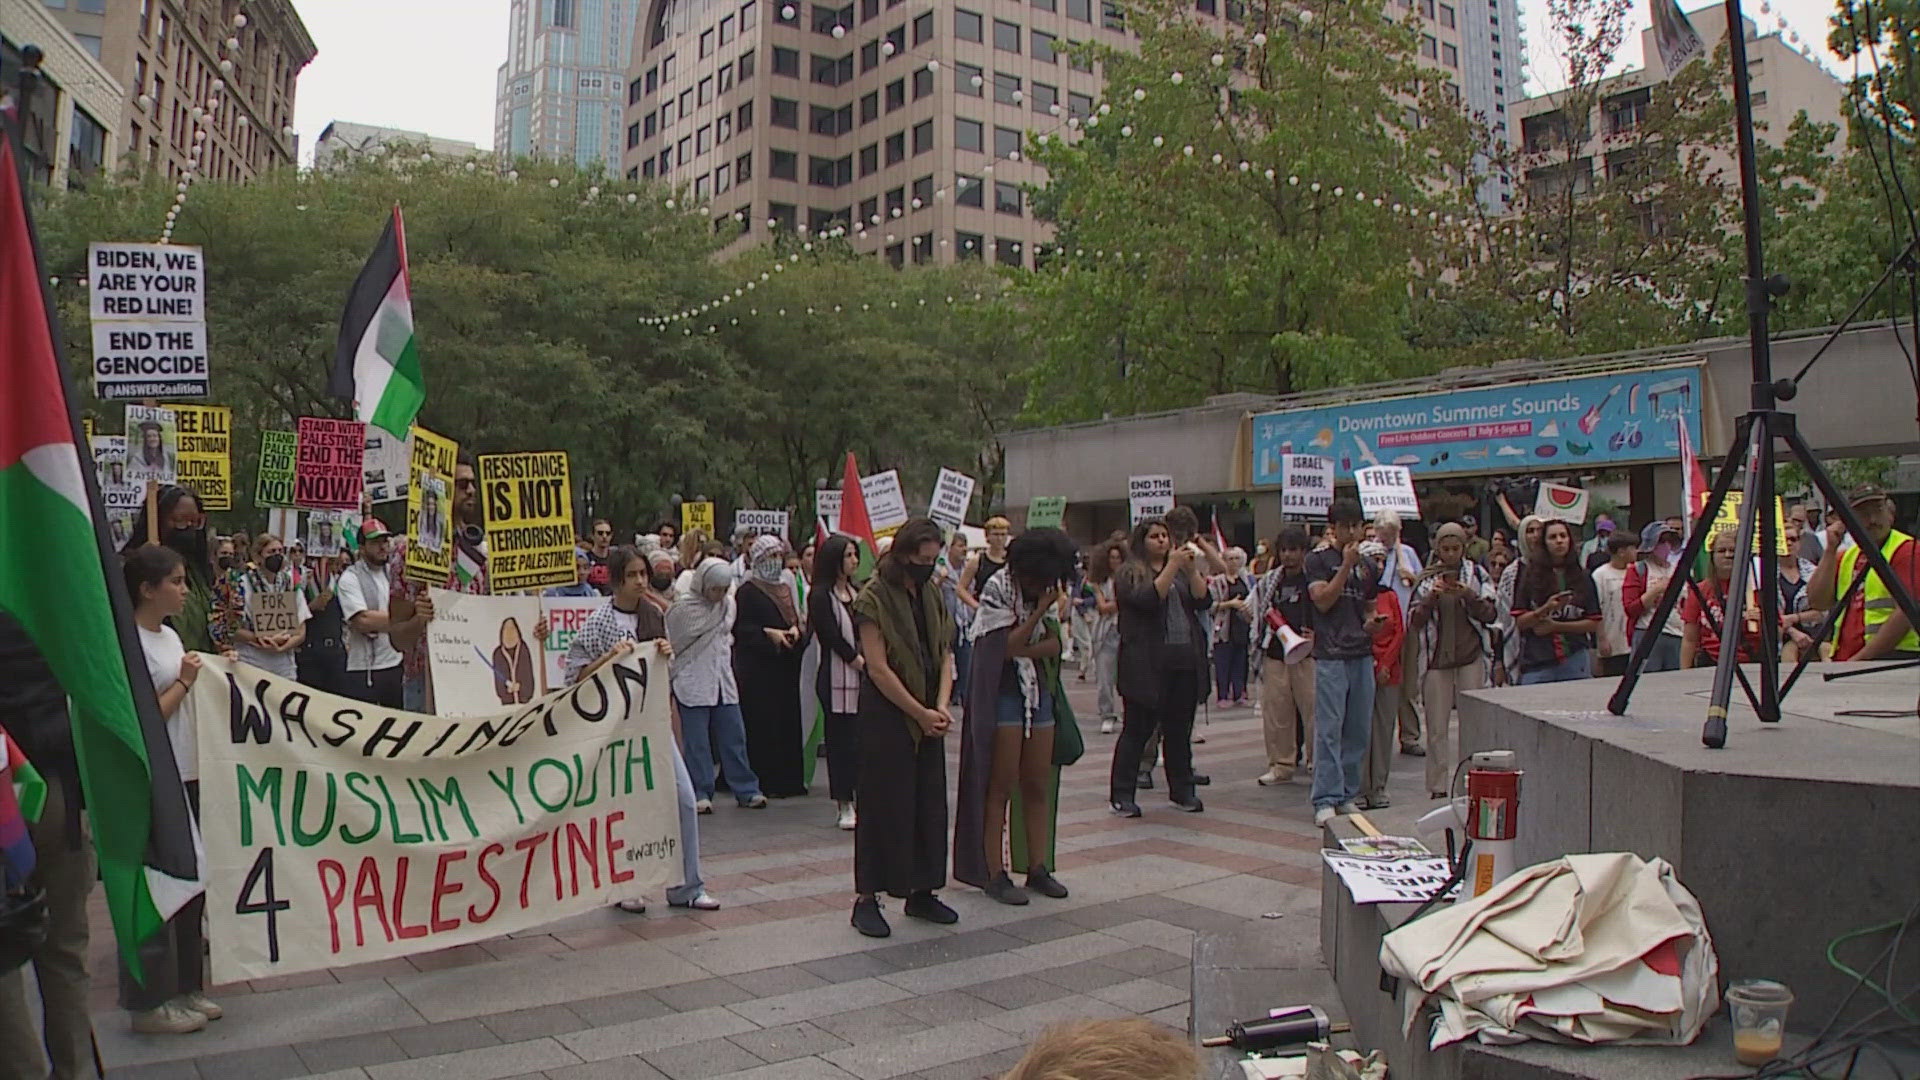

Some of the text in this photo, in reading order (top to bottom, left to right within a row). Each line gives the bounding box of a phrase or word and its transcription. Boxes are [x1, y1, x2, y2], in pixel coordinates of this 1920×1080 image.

[97, 250, 197, 271] BIDEN, WE
[98, 274, 196, 292] ARE YOUR
[104, 297, 192, 315] RED LINE!
[110, 332, 193, 350] END THE
[96, 356, 206, 375] GENOCIDE
[104, 383, 204, 398] @ANSWERCoalition
[129, 407, 173, 422] JUSTICE
[1338, 409, 1427, 432] Downtown
[1432, 402, 1507, 424] Summer
[1511, 393, 1581, 416] Sounds
[201, 411, 226, 434] ALL
[301, 420, 365, 434] STAND WITH
[177, 436, 227, 453] LESTINIAN
[265, 432, 295, 444] STAND
[300, 431, 363, 448] PALESTINE!
[264, 442, 297, 456] PALES
[300, 445, 363, 465] END THE
[413, 435, 453, 478] FREE ALL
[177, 460, 221, 477] OLITICAL
[263, 454, 290, 470] END
[484, 455, 566, 480] RESISTANCE
[1292, 457, 1324, 470] ISRAEL
[1131, 479, 1171, 489] END THE
[1362, 470, 1407, 487] FREE
[297, 475, 359, 502] NOW!
[1131, 490, 1172, 498] GENOCIDE
[487, 481, 512, 521] IS
[519, 479, 563, 519] NOT
[738, 513, 786, 525] GOOGLE
[1141, 506, 1164, 514] FREE
[488, 524, 572, 552] TERRORISM!
[492, 549, 574, 574] FREE PALESTINE!
[262, 594, 287, 610] FOR
[255, 612, 297, 632] EZGI
[225, 657, 649, 758] WASHINGTON
[235, 736, 655, 847] MUSLIM YOUTH
[235, 811, 634, 963] 4 PALESTINE
